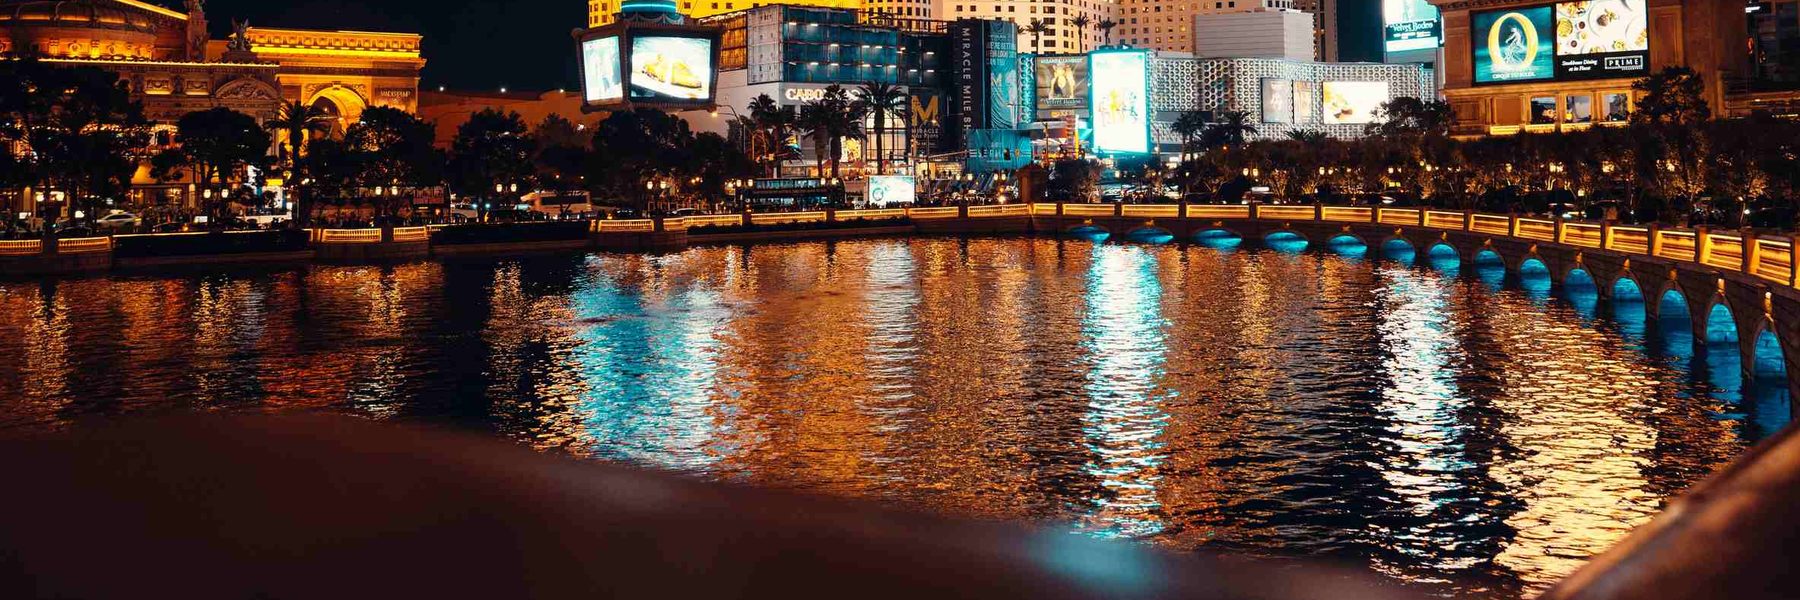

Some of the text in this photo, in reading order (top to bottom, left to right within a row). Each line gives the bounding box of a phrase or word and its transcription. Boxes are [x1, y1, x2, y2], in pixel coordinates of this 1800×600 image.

[962, 27, 971, 80] MIRACLE
[1488, 12, 1538, 68] O
[1608, 59, 1639, 68] PRIME
[785, 88, 824, 101] CABO
[963, 85, 971, 111] MILE
[911, 95, 939, 126] M
